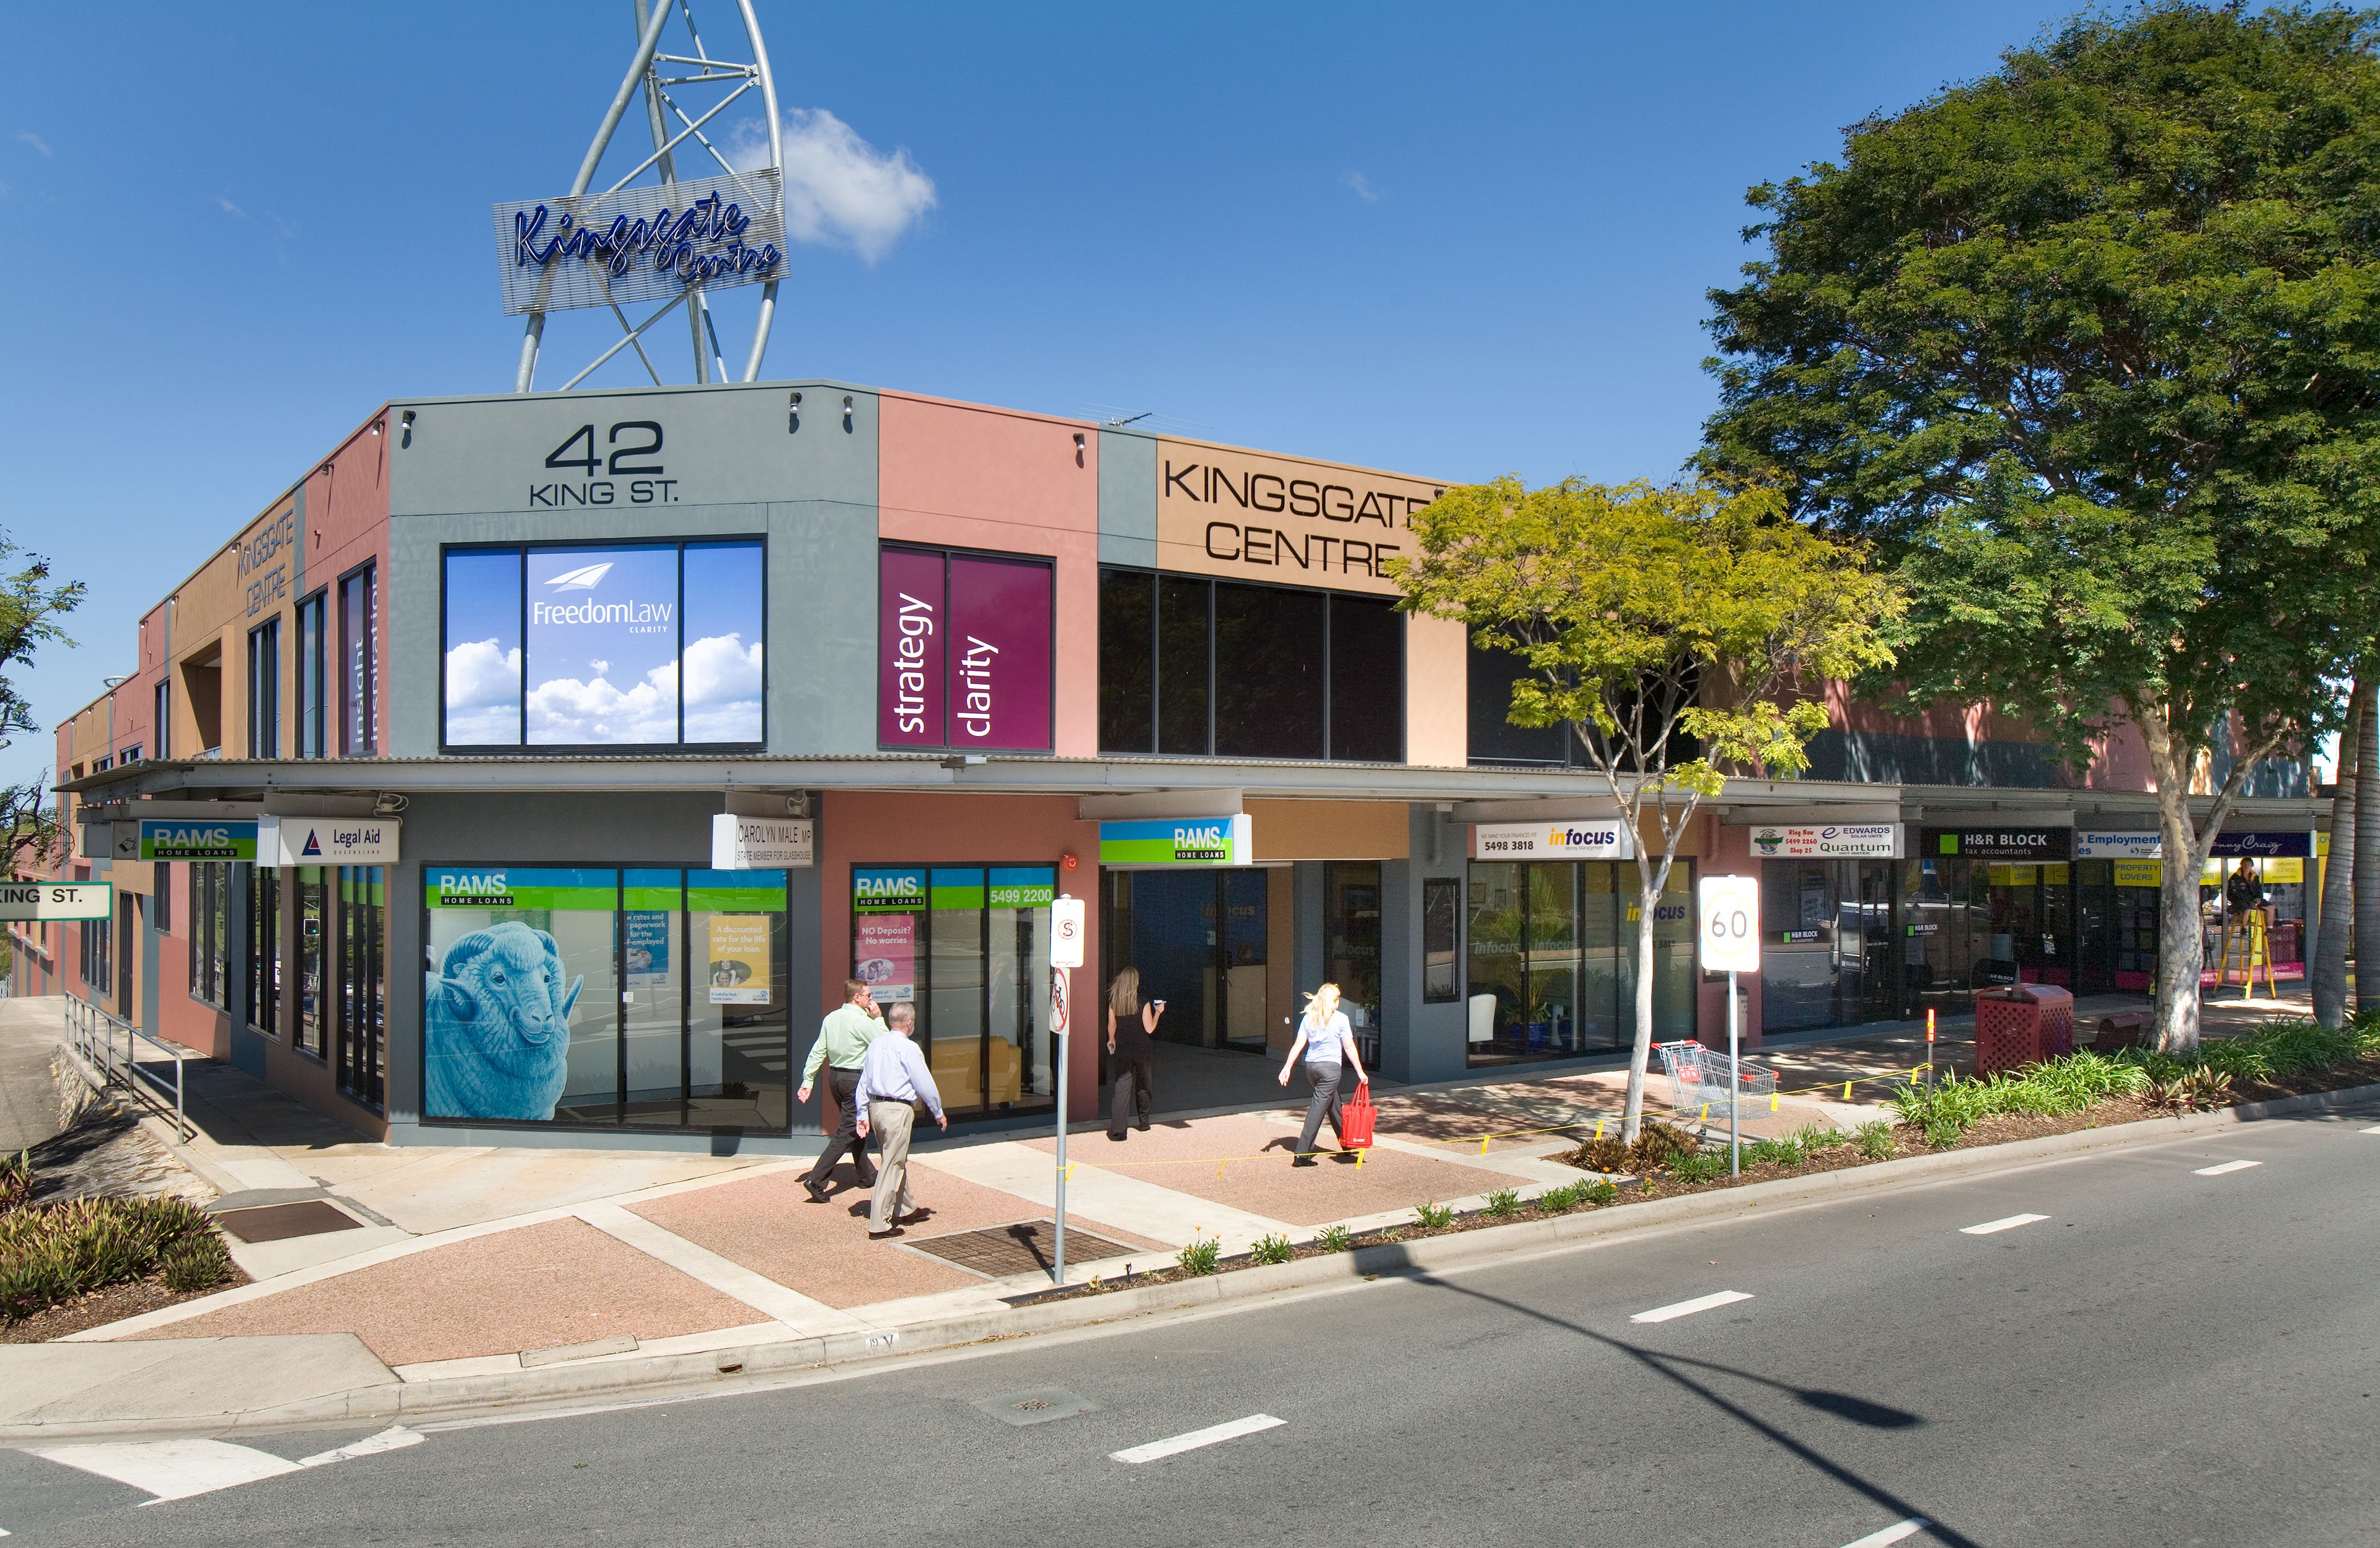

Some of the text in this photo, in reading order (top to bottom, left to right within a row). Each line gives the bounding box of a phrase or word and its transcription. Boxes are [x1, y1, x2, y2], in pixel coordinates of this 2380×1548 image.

[515, 190, 750, 277] Kingsgate
[671, 239, 782, 283] Centre
[545, 421, 664, 477] 42
[530, 480, 678, 506] KING ST.
[1165, 460, 1430, 531] KINGSGATE
[240, 508, 294, 579] KINGSGATE
[1205, 522, 1401, 578] CENTRE
[247, 563, 286, 617] CENTRE
[534, 598, 672, 624] FreedomLaw
[893, 592, 933, 734] strategy
[957, 635, 998, 737] clarity
[154, 828, 229, 847] RAMS
[333, 829, 380, 848] Legal Aid
[738, 825, 811, 843] CAROLYN MALE MP
[1175, 827, 1220, 848] RAMS
[1549, 828, 1615, 845] infocus
[1965, 834, 2047, 845] H&R BLOCK
[1485, 841, 1533, 851] 5498 3818
[1820, 842, 1890, 852] Quantum
[2211, 834, 2282, 855] enny Craig
[738, 851, 752, 860] STATE
[754, 851, 773, 860] MEMBER
[774, 851, 783, 860] FOR
[441, 874, 506, 895] RAMS
[857, 876, 917, 896] RAMS
[0, 889, 82, 903] ING ST.
[990, 889, 1051, 903] 5499 2200
[1626, 902, 1686, 921] incus
[630, 921, 666, 930] paperwork
[878, 926, 910, 936] Deposit?
[1064, 922, 1073, 937] S
[1712, 910, 1747, 938] 60
[627, 937, 664, 946] f-employed
[879, 936, 907, 944] worries
[1474, 941, 1520, 955] infocus
